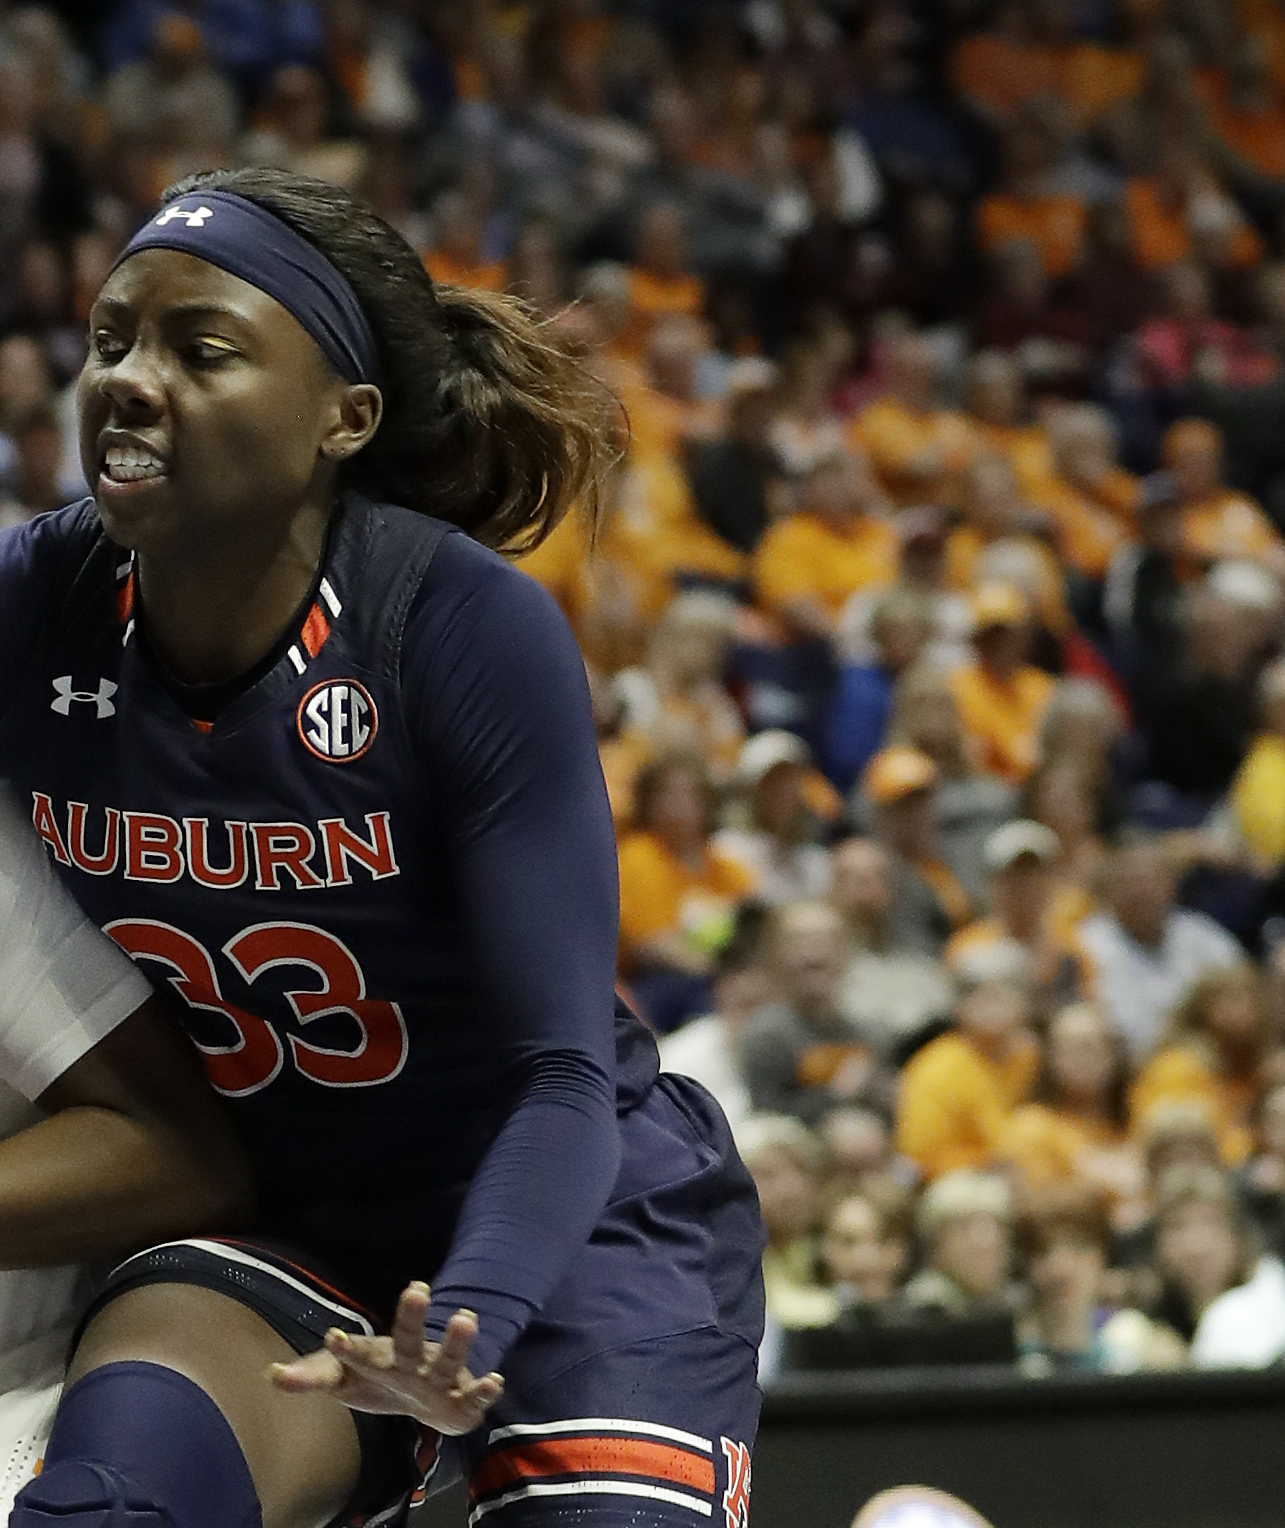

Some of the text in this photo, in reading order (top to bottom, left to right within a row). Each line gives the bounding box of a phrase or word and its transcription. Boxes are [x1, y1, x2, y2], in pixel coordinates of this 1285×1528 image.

[305, 686, 371, 757] SEC
[32, 791, 400, 890] AUBURN
[101, 918, 409, 1098] 33
